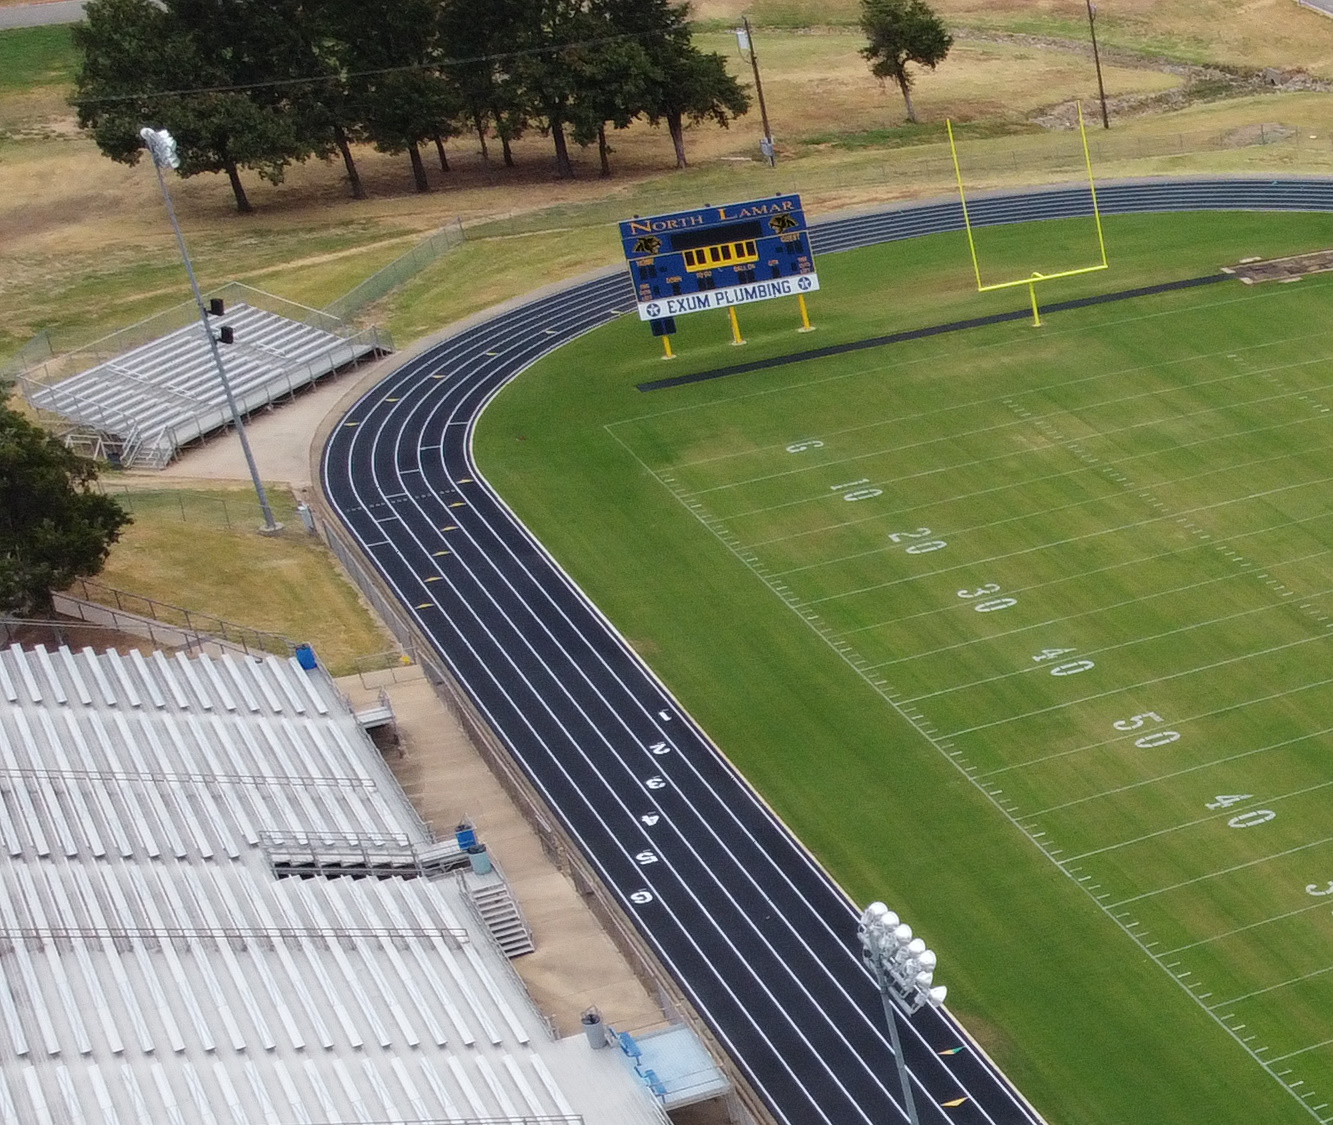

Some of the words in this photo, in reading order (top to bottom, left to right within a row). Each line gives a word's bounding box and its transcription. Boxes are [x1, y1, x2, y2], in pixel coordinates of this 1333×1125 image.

[628, 216, 703, 235] NORTH
[718, 201, 795, 221] LAMAR
[666, 295, 710, 315] EXUM
[716, 280, 792, 306] PLUMBING
[830, 478, 883, 501] 10
[888, 527, 947, 554] 20
[957, 583, 1017, 613] 30
[1032, 647, 1094, 676] 40
[658, 711, 672, 721] 1
[1113, 711, 1180, 748] 50
[649, 743, 670, 755] 2
[645, 778, 666, 789] 3
[641, 815, 659, 826] 4
[1204, 793, 1276, 828] 40
[635, 852, 658, 865] 5
[630, 891, 653, 904] 6
